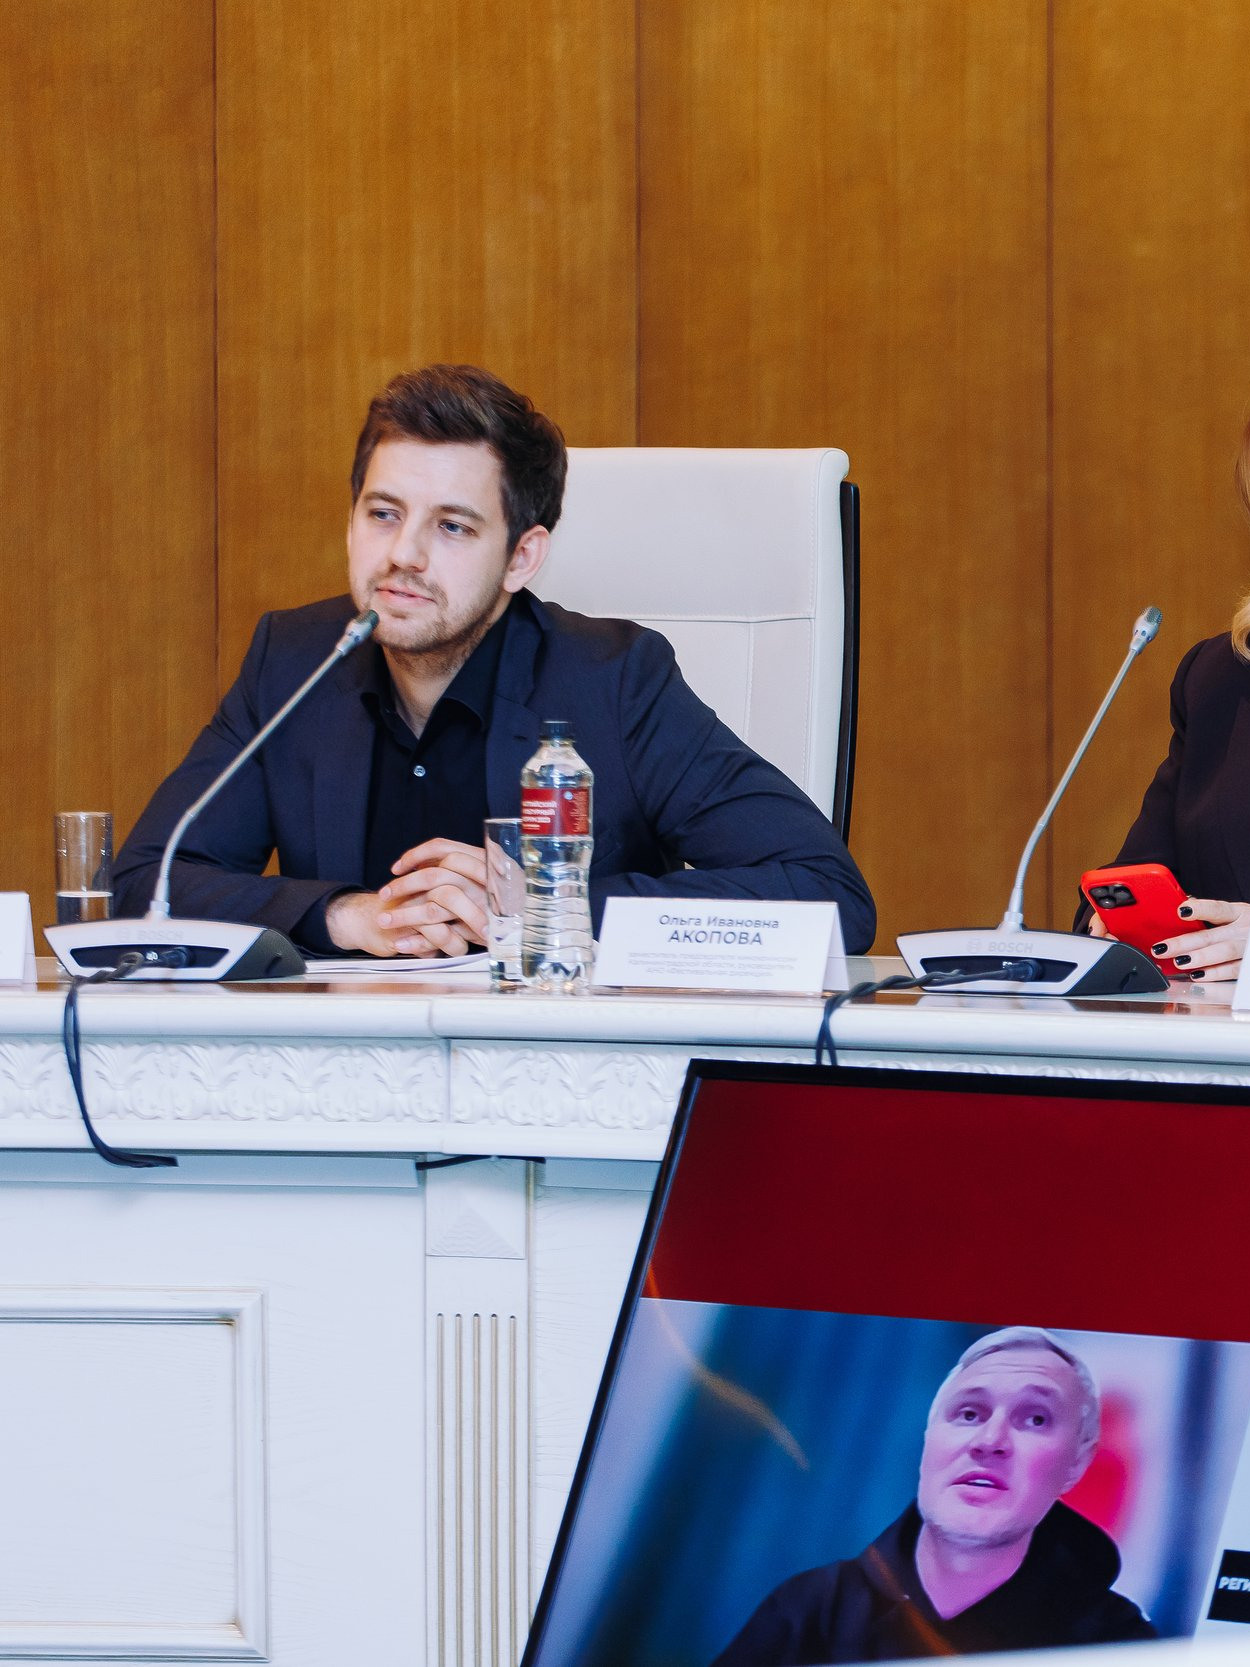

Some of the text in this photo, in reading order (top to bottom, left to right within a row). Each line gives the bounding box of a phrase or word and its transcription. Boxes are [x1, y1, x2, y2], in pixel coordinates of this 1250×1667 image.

[659, 914, 779, 929] Ольга Ивановна
[668, 929, 763, 945] АКОПОВА
[988, 942, 1034, 953] BOSCH
